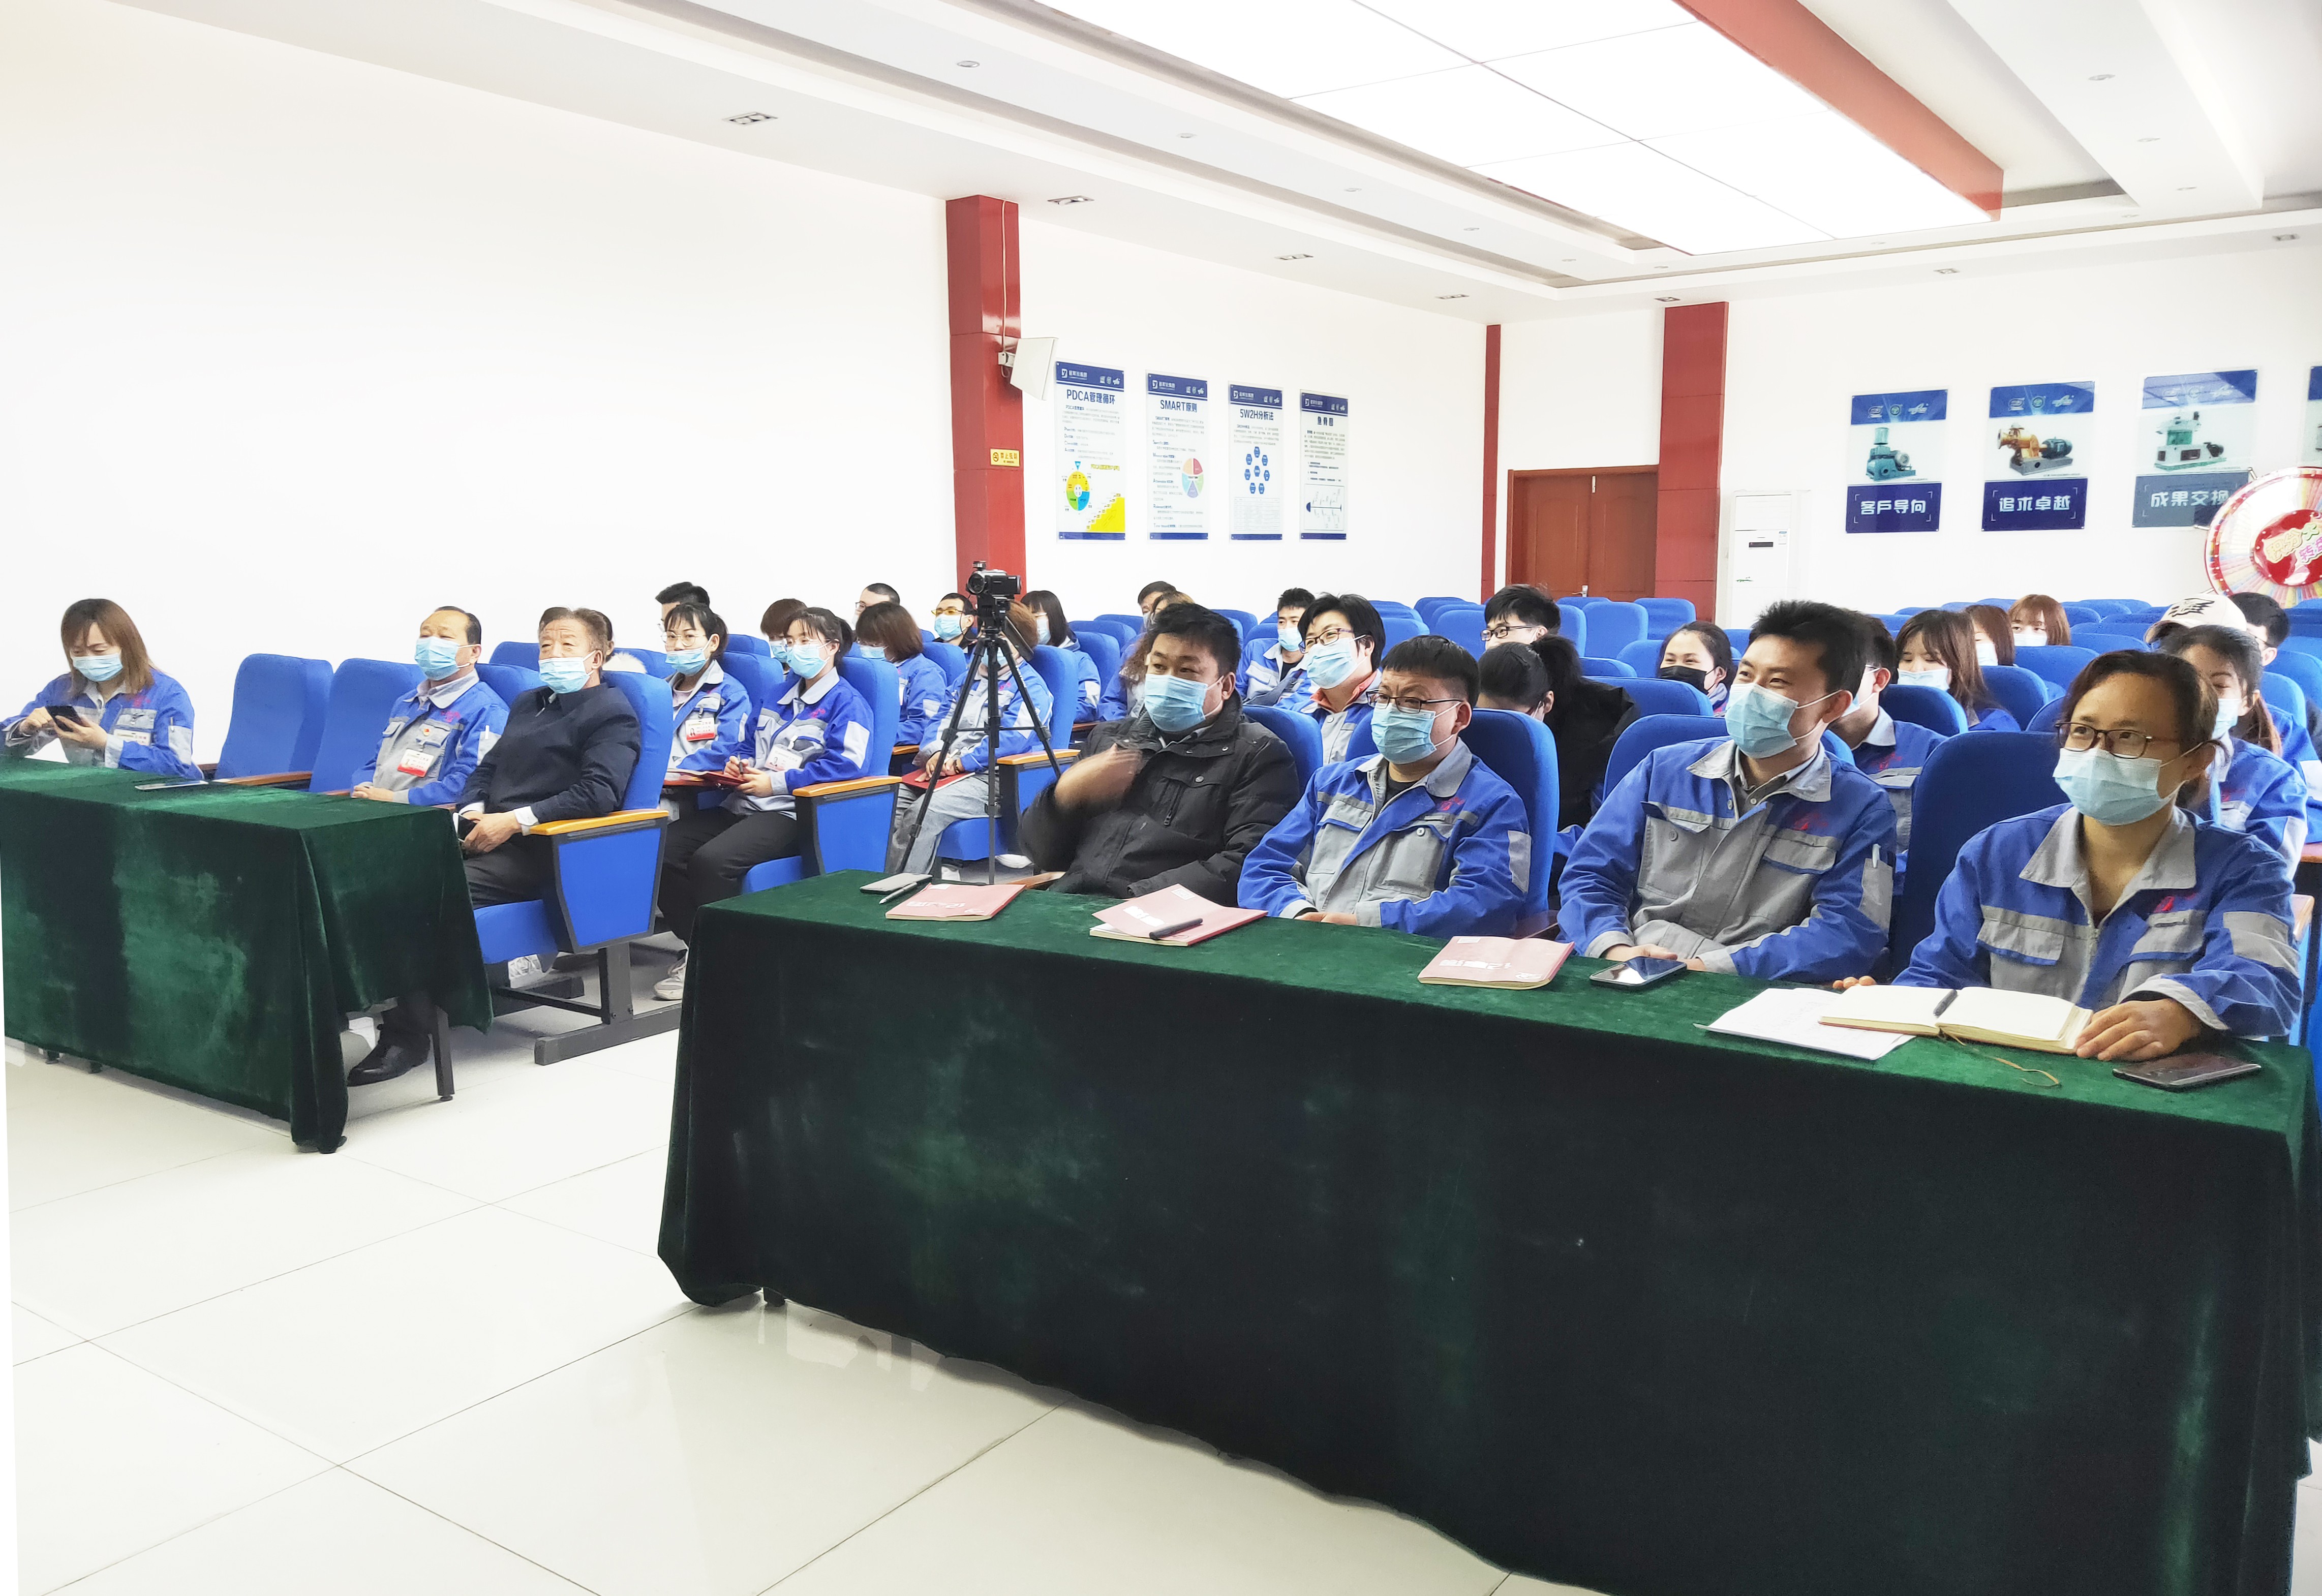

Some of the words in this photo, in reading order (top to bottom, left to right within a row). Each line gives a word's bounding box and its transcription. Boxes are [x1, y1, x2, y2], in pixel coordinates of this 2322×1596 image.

[1066, 389, 1115, 405] PDCA管理循环
[1160, 400, 1197, 413] SMART原则
[1240, 409, 1274, 421] 5W2H分析法
[1998, 495, 2071, 512] 追求卓越
[2150, 489, 2230, 508] 成果交换
[1860, 499, 1926, 515] 客户导向
